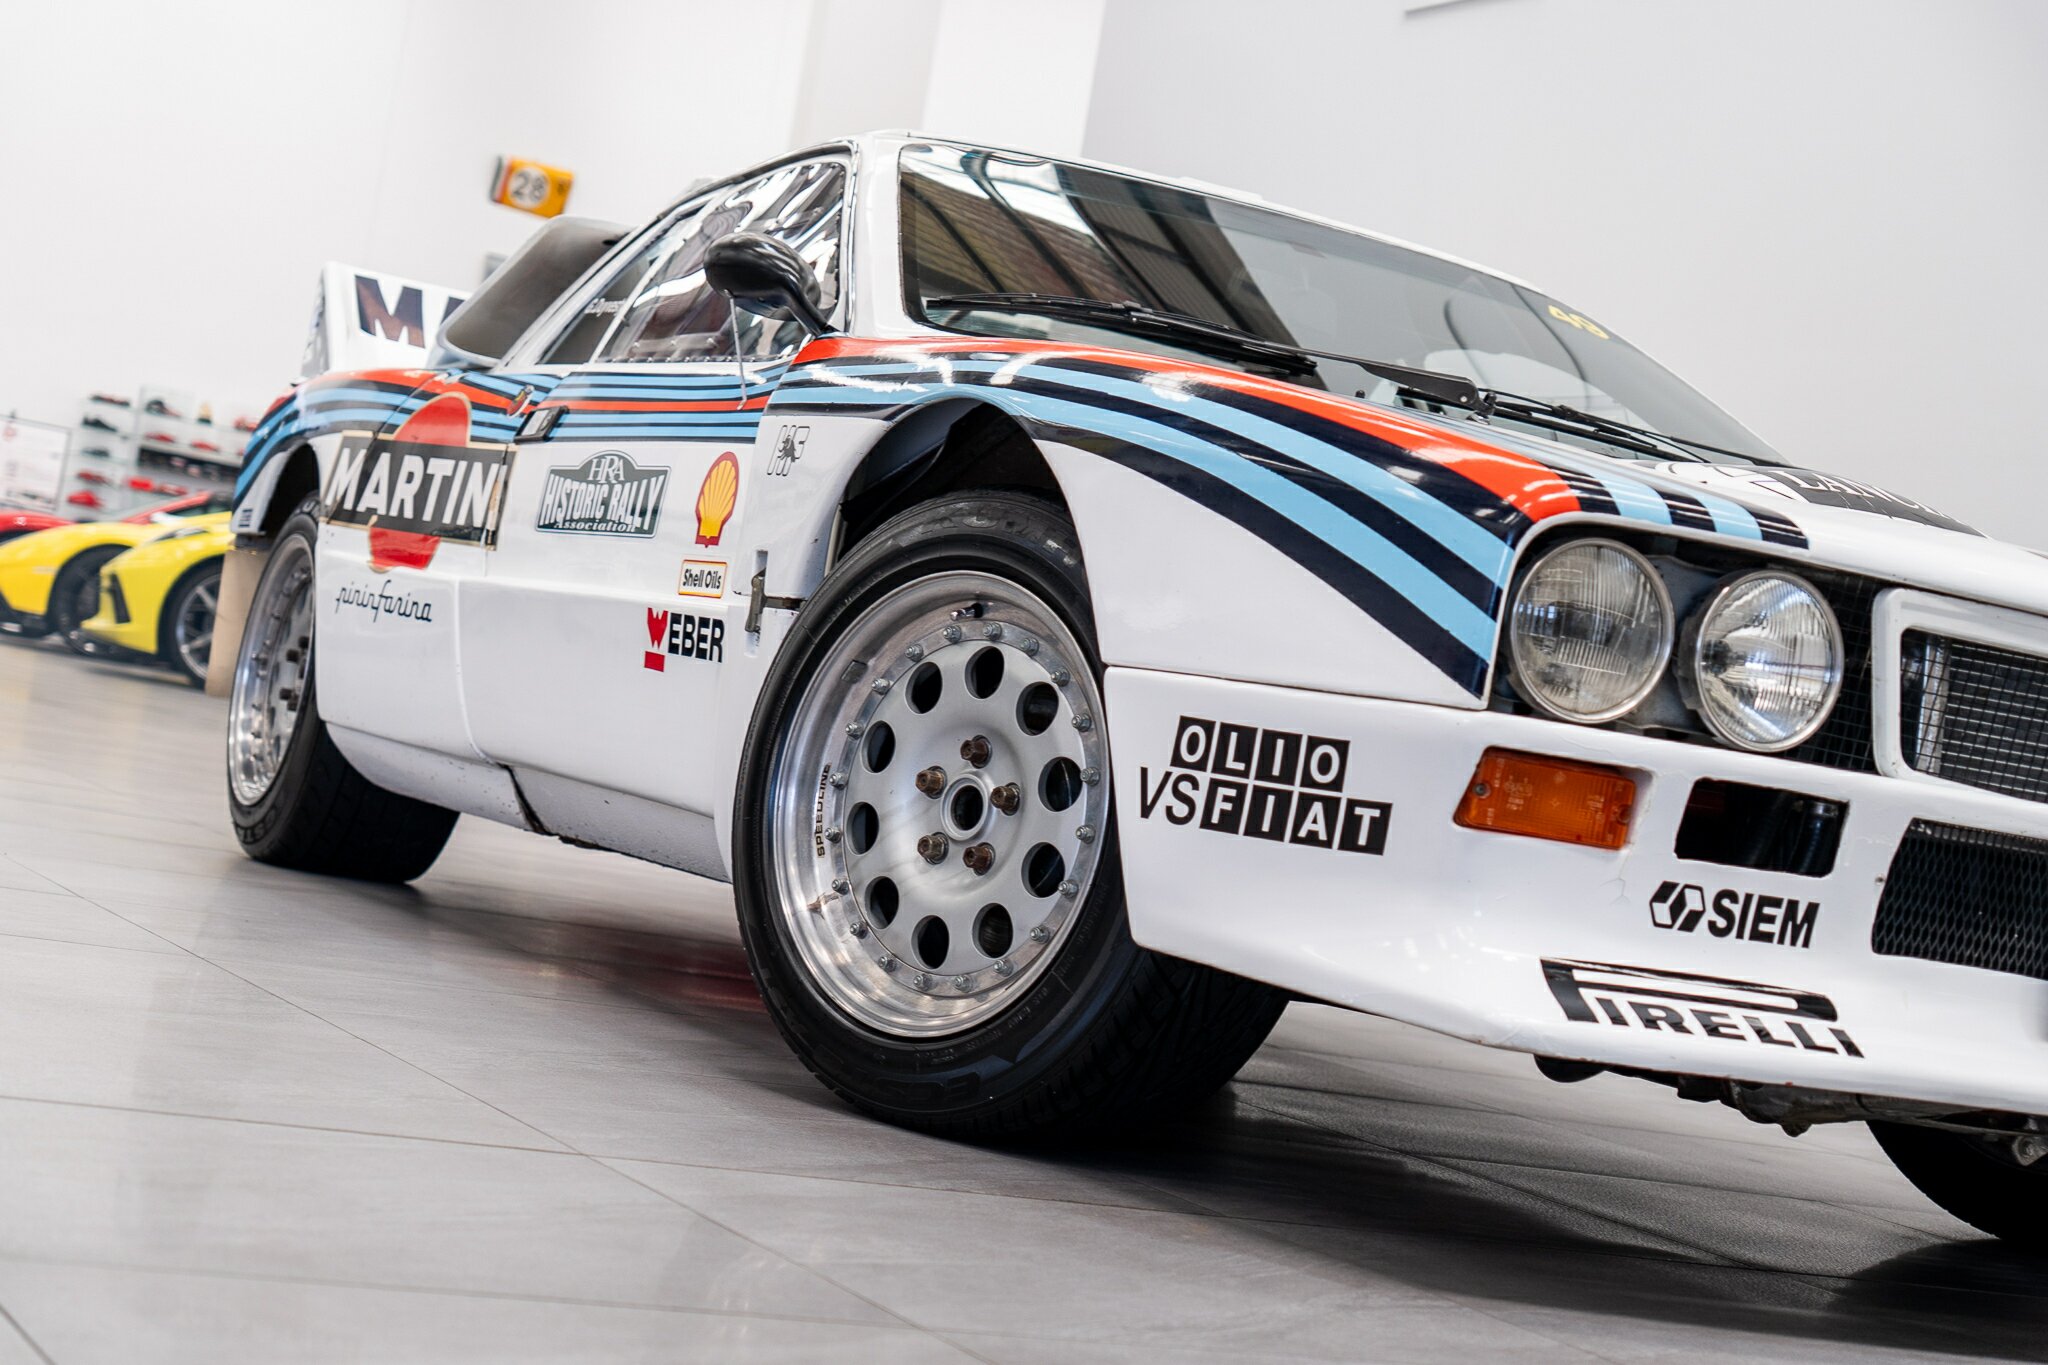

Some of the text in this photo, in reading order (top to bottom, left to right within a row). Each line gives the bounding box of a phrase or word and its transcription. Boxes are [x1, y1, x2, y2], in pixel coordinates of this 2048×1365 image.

[587, 455, 626, 484] HRA
[1768, 470, 1948, 517] LANC
[539, 473, 666, 531] HISTORIC RALLY
[554, 519, 637, 533] Association
[335, 579, 432, 623] pininfarina
[682, 568, 722, 590] Shell Oils
[646, 606, 725, 664] WEBER
[1176, 722, 1344, 787] OLIO
[815, 762, 832, 859] SPEEDLINE
[1207, 784, 1384, 850] FIAT
[1706, 887, 1821, 949] SIEM
[1539, 956, 1865, 1059] PIRELLI
